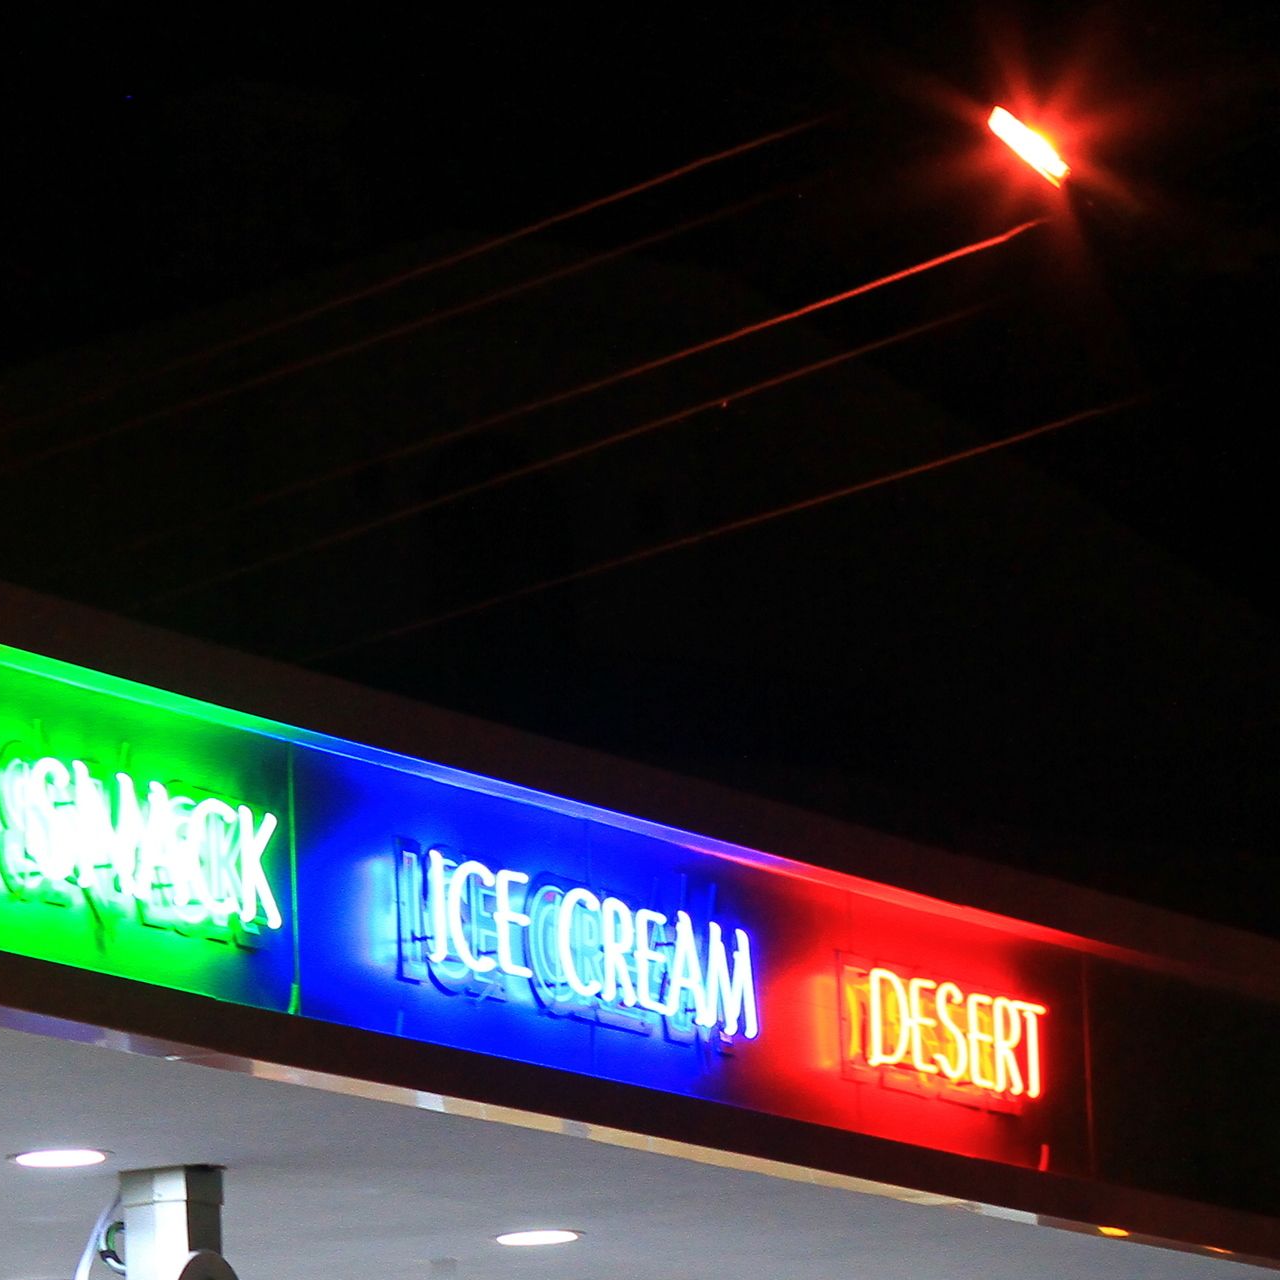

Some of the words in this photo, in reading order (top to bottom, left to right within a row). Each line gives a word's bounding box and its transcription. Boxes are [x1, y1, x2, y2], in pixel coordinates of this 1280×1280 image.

[427, 849, 532, 980] ICE
[556, 886, 759, 1041] CREAM
[866, 967, 1048, 1100] DESERT
